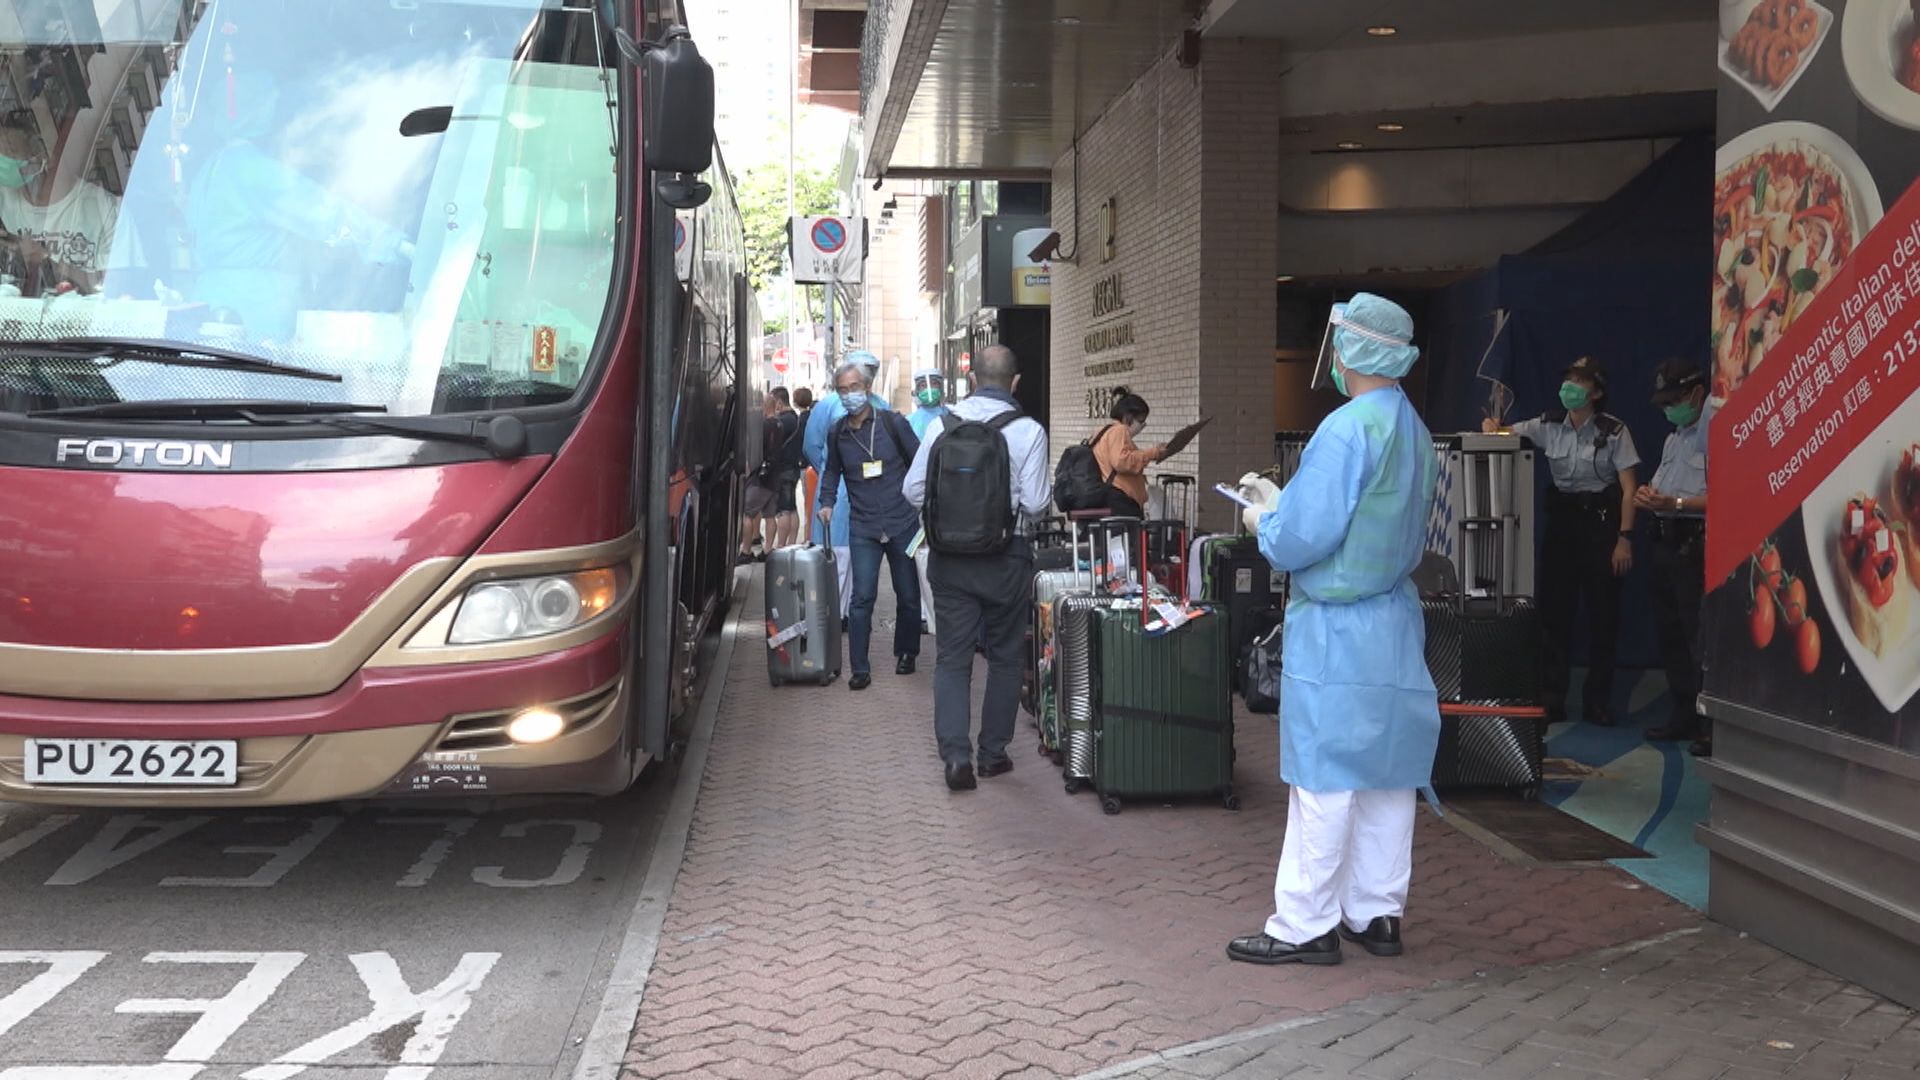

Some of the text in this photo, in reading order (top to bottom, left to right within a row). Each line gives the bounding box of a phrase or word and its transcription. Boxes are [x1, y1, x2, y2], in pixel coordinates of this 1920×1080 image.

[1092, 273, 1124, 317] REGAL
[1731, 389, 1775, 449] Savour
[1776, 316, 1843, 399] authentic
[1840, 263, 1891, 325] Italian
[57, 438, 232, 468] FOTON
[1768, 410, 1844, 495] Reservation
[37, 743, 225, 777] PU 2622
